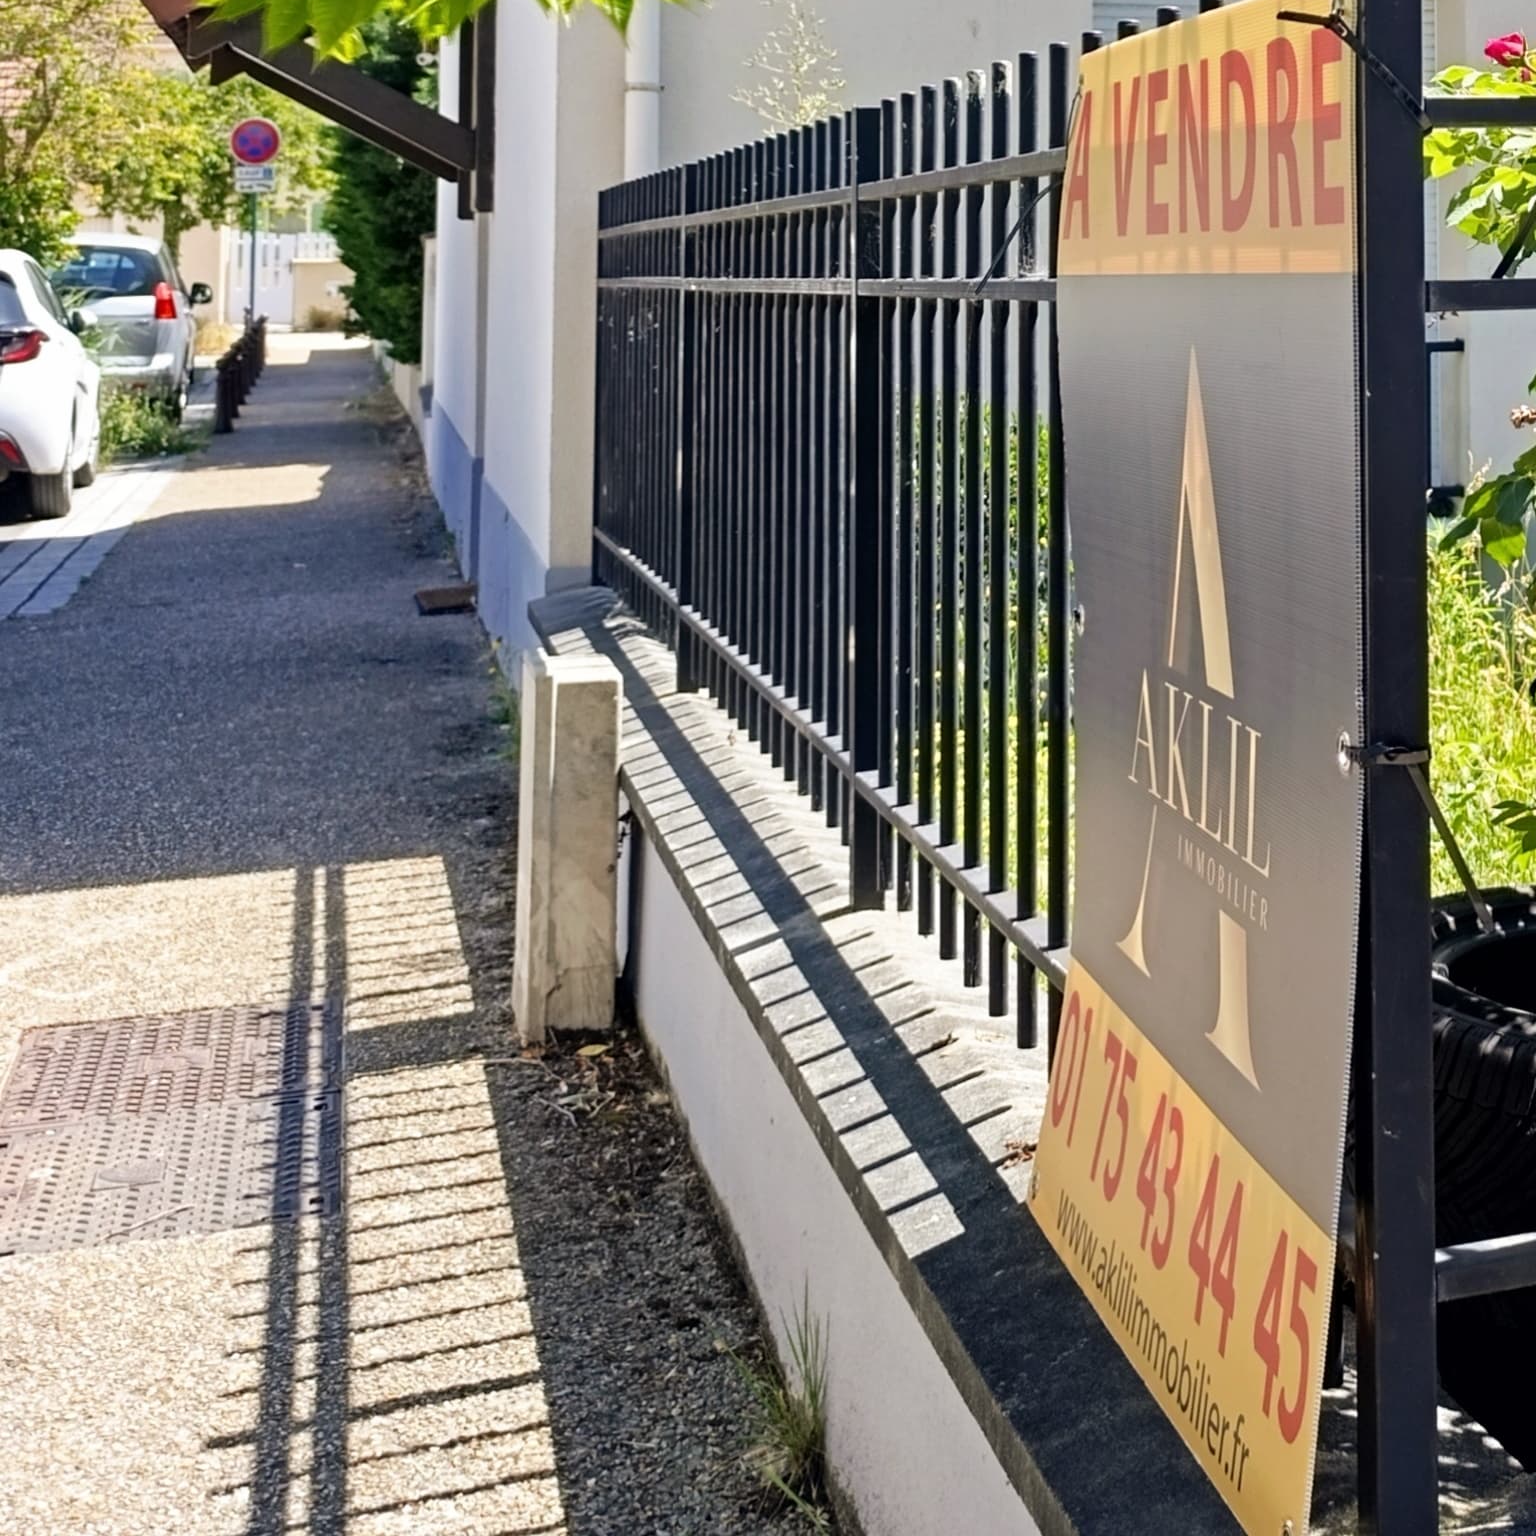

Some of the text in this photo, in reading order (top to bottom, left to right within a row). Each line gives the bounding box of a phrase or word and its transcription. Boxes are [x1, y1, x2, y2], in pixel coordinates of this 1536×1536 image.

[1062, 27, 1346, 240] A VENDRE
[1127, 667, 1270, 879] AKLIL
[1177, 833, 1269, 931] IMMOBILIER
[1050, 990, 1318, 1444] 01 75 43 44 45
[1056, 1187, 1250, 1493] www.aklilimmobilier.fr
